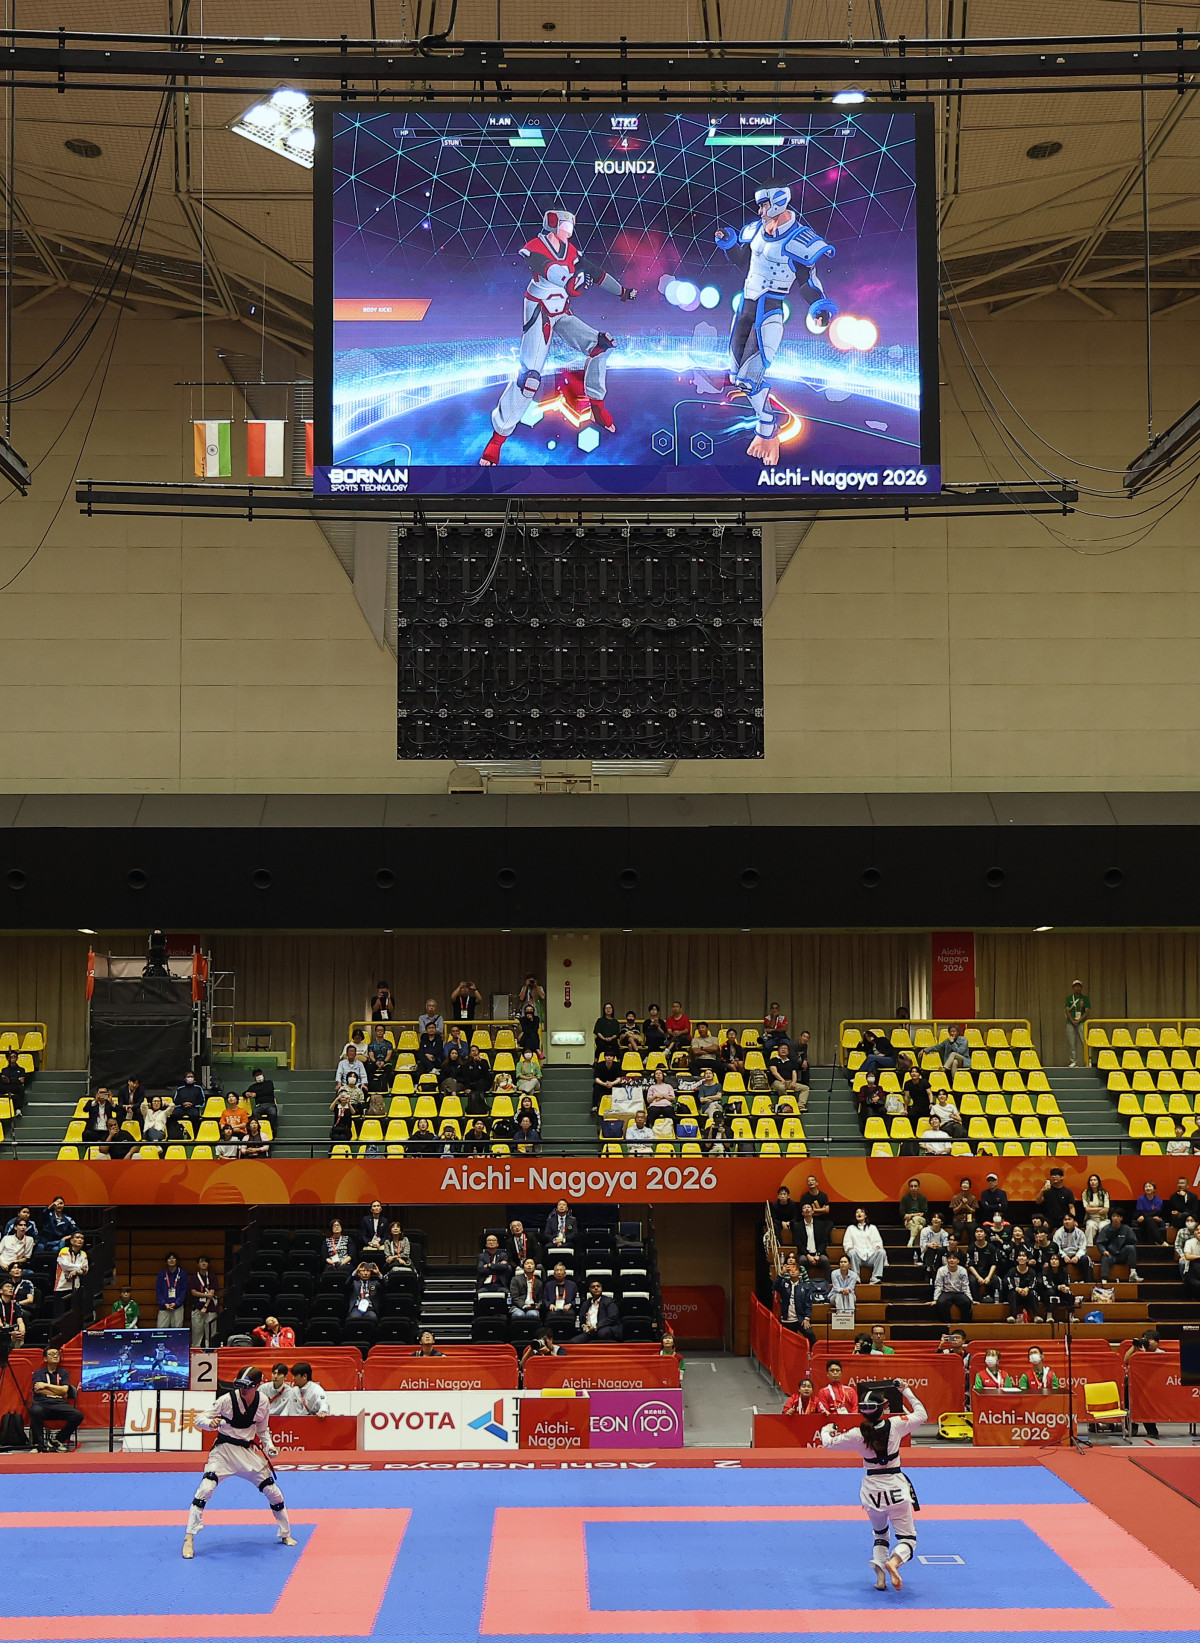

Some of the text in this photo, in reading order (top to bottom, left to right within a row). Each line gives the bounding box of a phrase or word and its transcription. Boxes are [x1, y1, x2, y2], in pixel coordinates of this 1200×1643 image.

[489, 117, 511, 126] H.AN
[611, 117, 638, 127] VTKD
[739, 117, 773, 126] N.CHAU
[621, 138, 628, 148] 4
[594, 160, 655, 174] ROUND2
[327, 468, 409, 484] BORNAN
[757, 468, 928, 491] Aichi-Nagoya 2026
[330, 484, 409, 492] SPORTS TECHNOLOGY
[937, 955, 969, 964] Nagoya
[440, 1164, 717, 1198] Aichi-Nagoya 2026
[663, 1303, 698, 1313] Nagoya
[197, 1361, 213, 1383] 2
[400, 1378, 482, 1391] Aichi-Nagoya
[562, 1377, 643, 1389] Aichi-Nagoya
[364, 1411, 456, 1430] OYOTA
[590, 1416, 629, 1433] EON
[534, 1421, 576, 1434] Aichi-
[1011, 1427, 1050, 1440] 2026
[268, 1430, 300, 1444] ichi-
[528, 1435, 581, 1449] Nagoya
[869, 1489, 905, 1508] VIE
